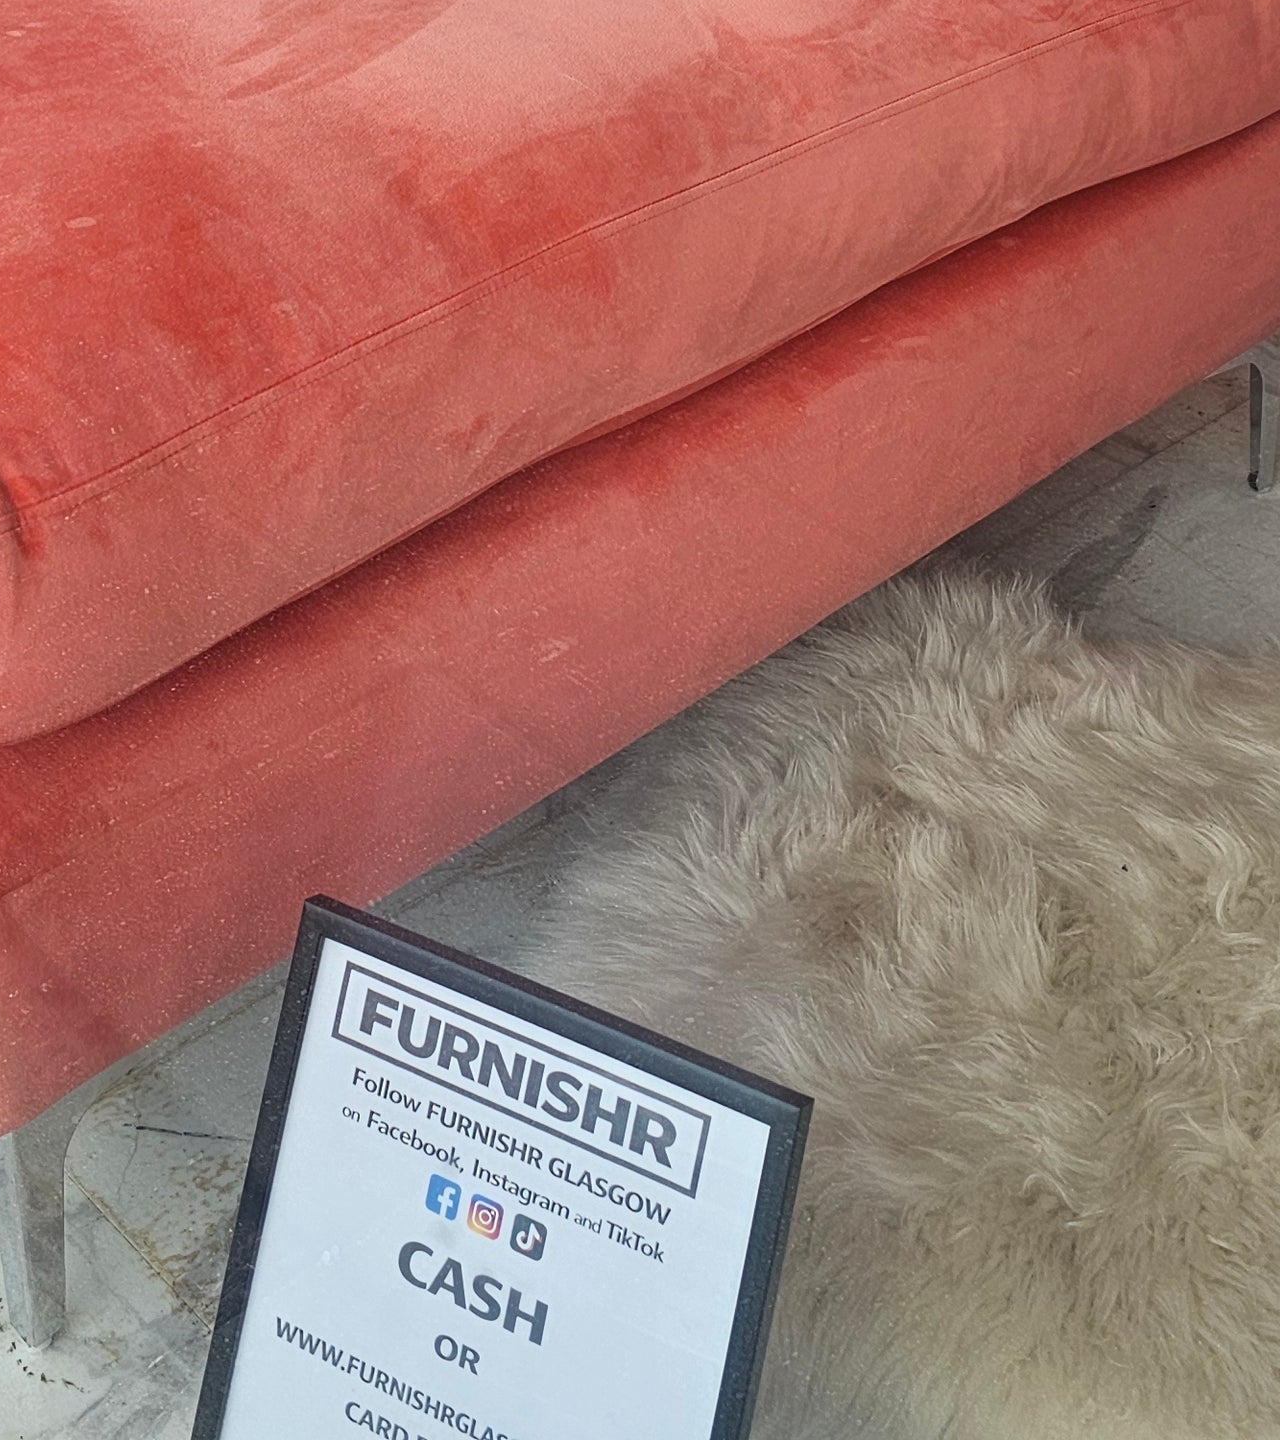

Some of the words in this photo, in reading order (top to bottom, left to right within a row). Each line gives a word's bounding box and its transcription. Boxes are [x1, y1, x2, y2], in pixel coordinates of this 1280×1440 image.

[358, 987, 678, 1169] FURNISHR
[341, 1103, 361, 1124] on
[366, 1111, 466, 1175] Facebook,
[472, 1158, 571, 1220] Instagram
[573, 1208, 603, 1236] and
[606, 1220, 666, 1264] TikTok
[352, 1066, 422, 1114] Follow
[425, 1103, 544, 1171] FURNISHR
[547, 1156, 673, 1226] GLASGOW
[398, 1240, 549, 1347] CASH
[433, 1333, 481, 1376] OR
[275, 1315, 510, 1440] WWW.FURNISHRGLA
[344, 1401, 410, 1440] CARD
